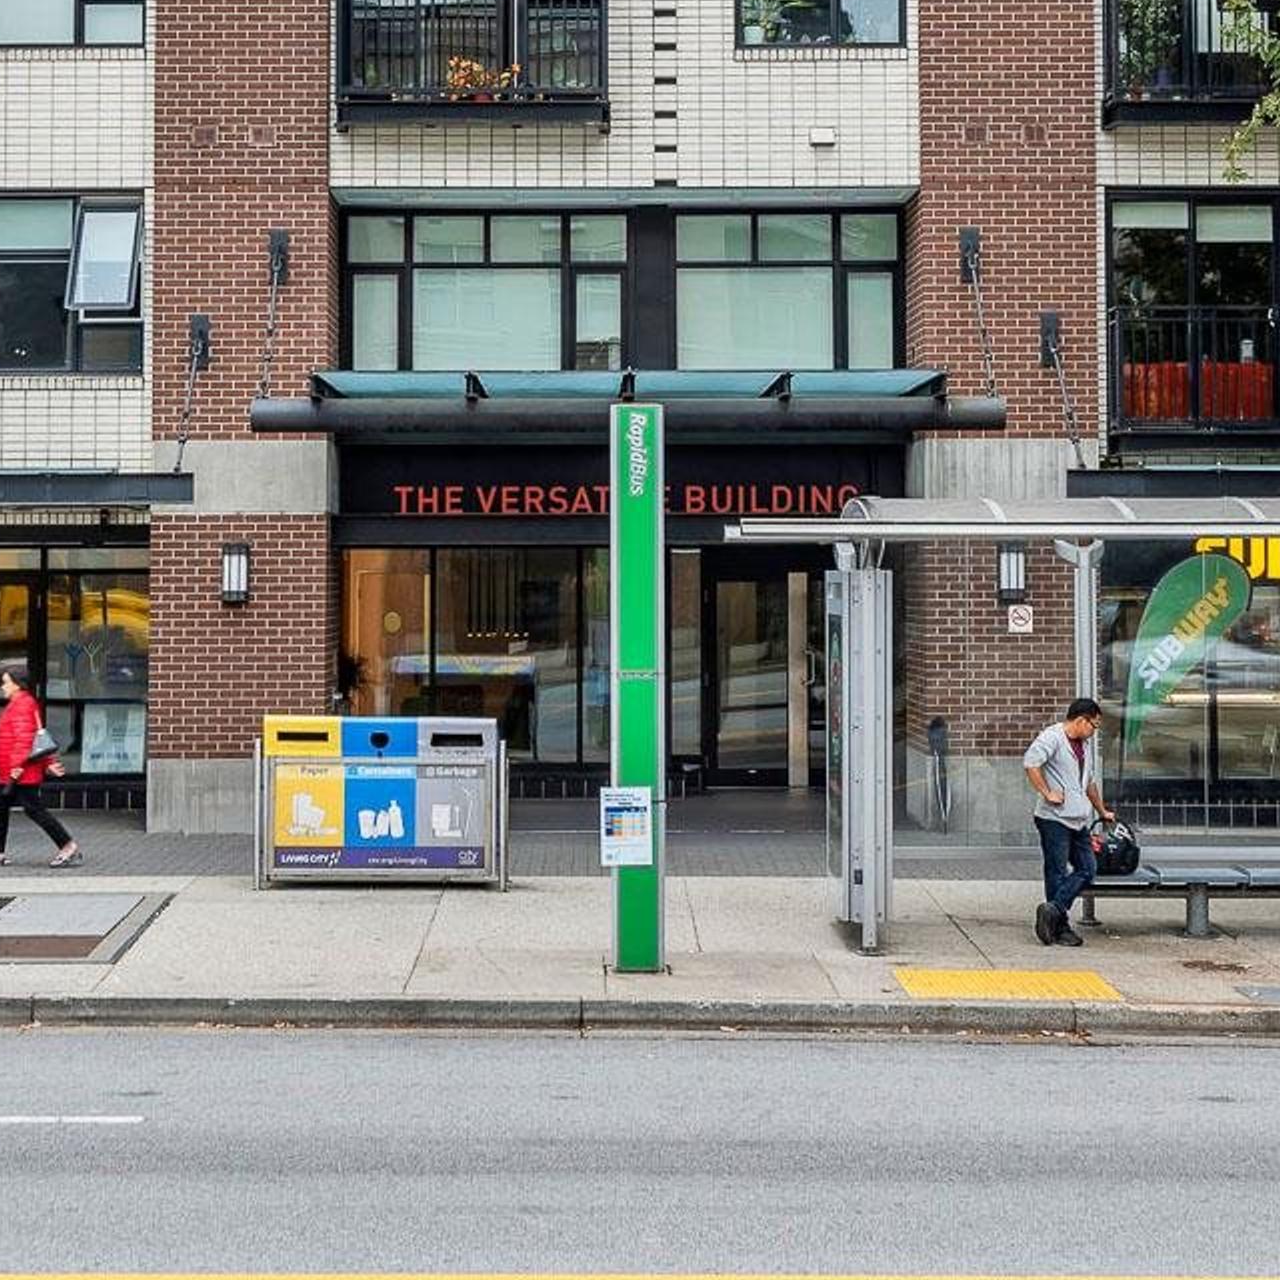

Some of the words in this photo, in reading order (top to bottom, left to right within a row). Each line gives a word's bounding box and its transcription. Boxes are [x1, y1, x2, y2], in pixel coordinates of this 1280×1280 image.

[627, 413, 647, 497] RapidBus
[394, 486, 464, 514] THE
[474, 486, 671, 514] VERSAT
[1138, 576, 1229, 689] SUBWAY
[436, 766, 477, 777] Garbage
